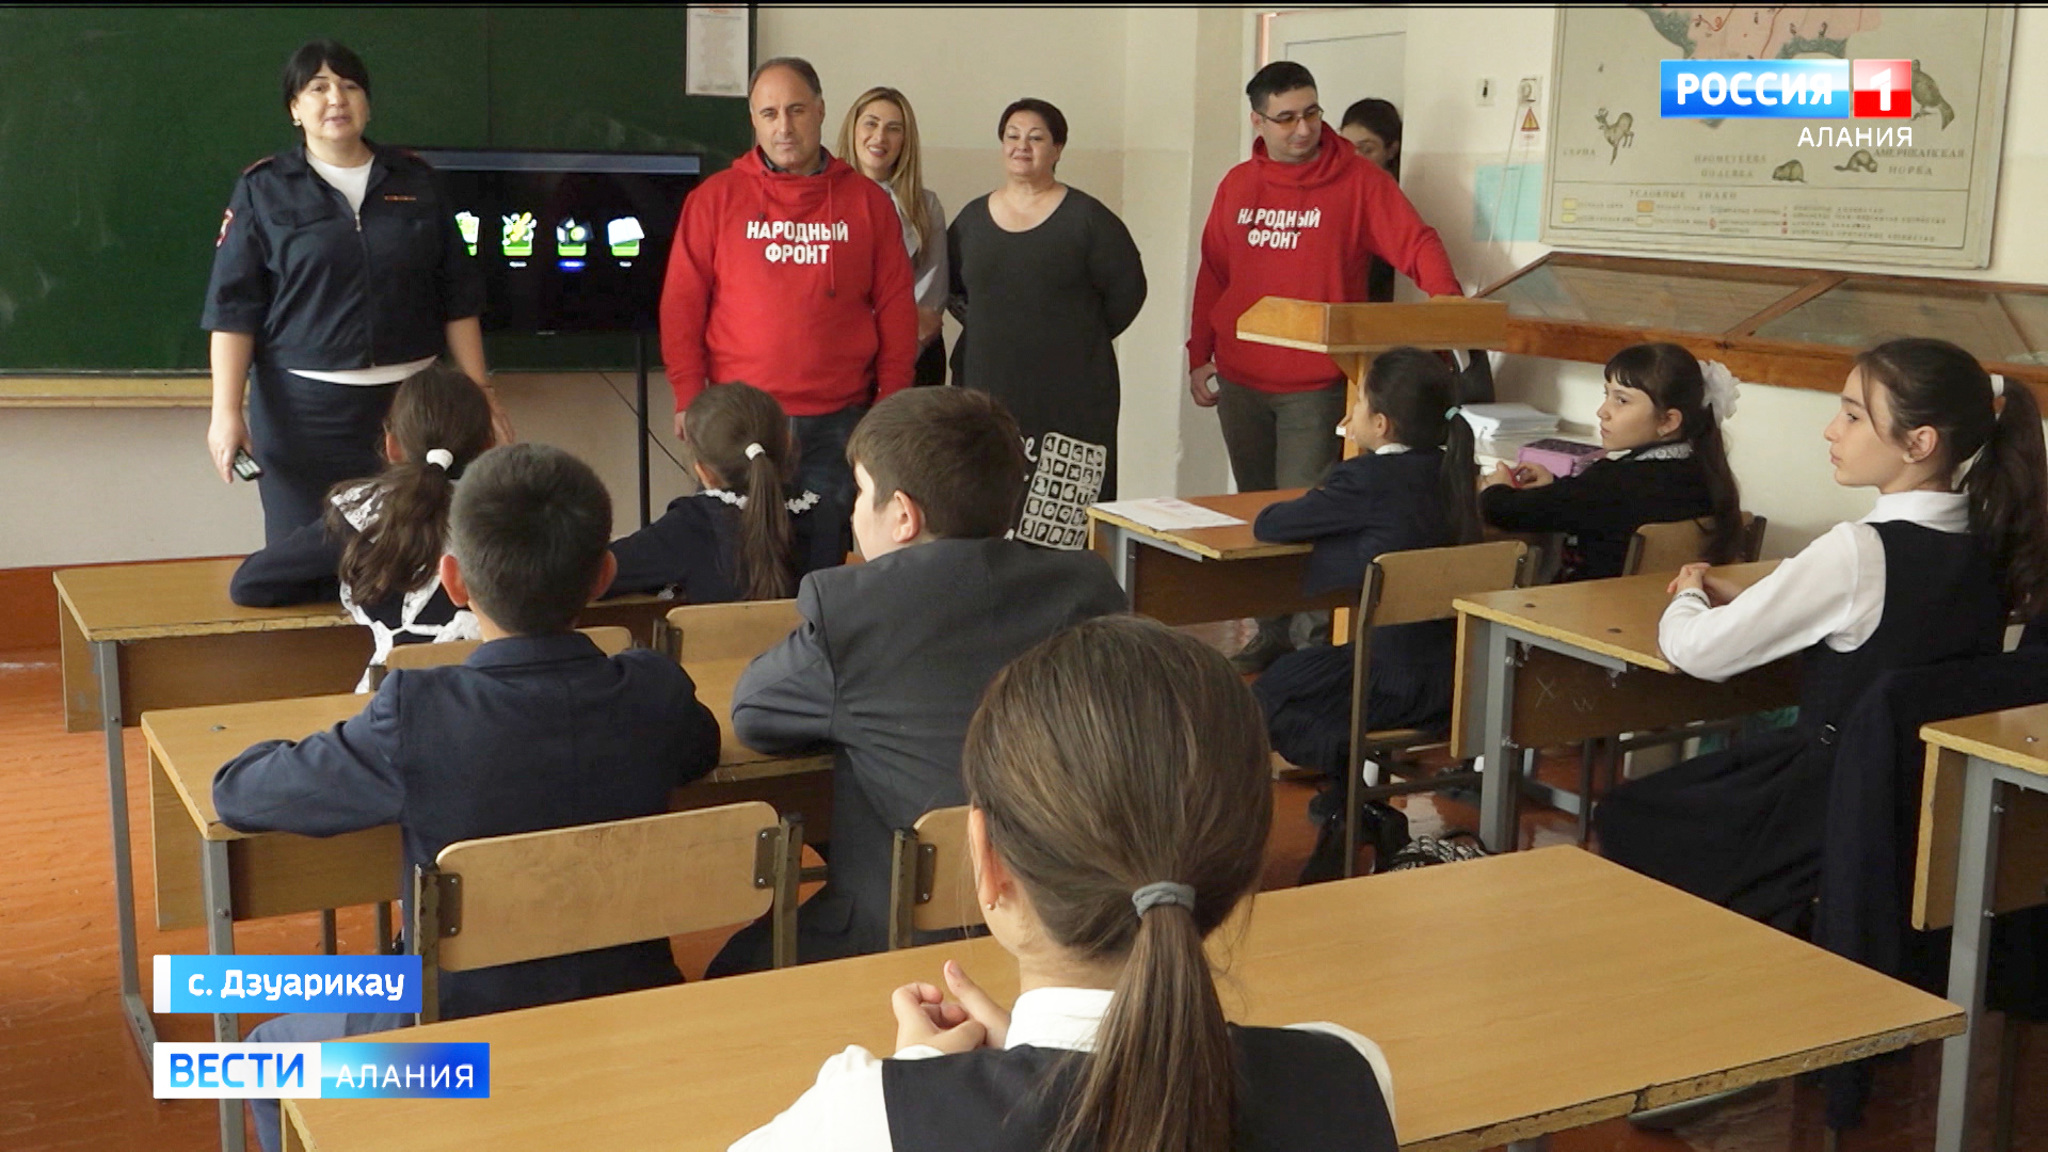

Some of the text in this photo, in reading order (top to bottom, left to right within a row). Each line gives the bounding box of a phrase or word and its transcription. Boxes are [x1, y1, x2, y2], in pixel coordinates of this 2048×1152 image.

[746, 219, 849, 243] НАРОДНЫЙ
[1247, 228, 1301, 250] ФРОНТ
[765, 242, 830, 264] ФРОНТ
